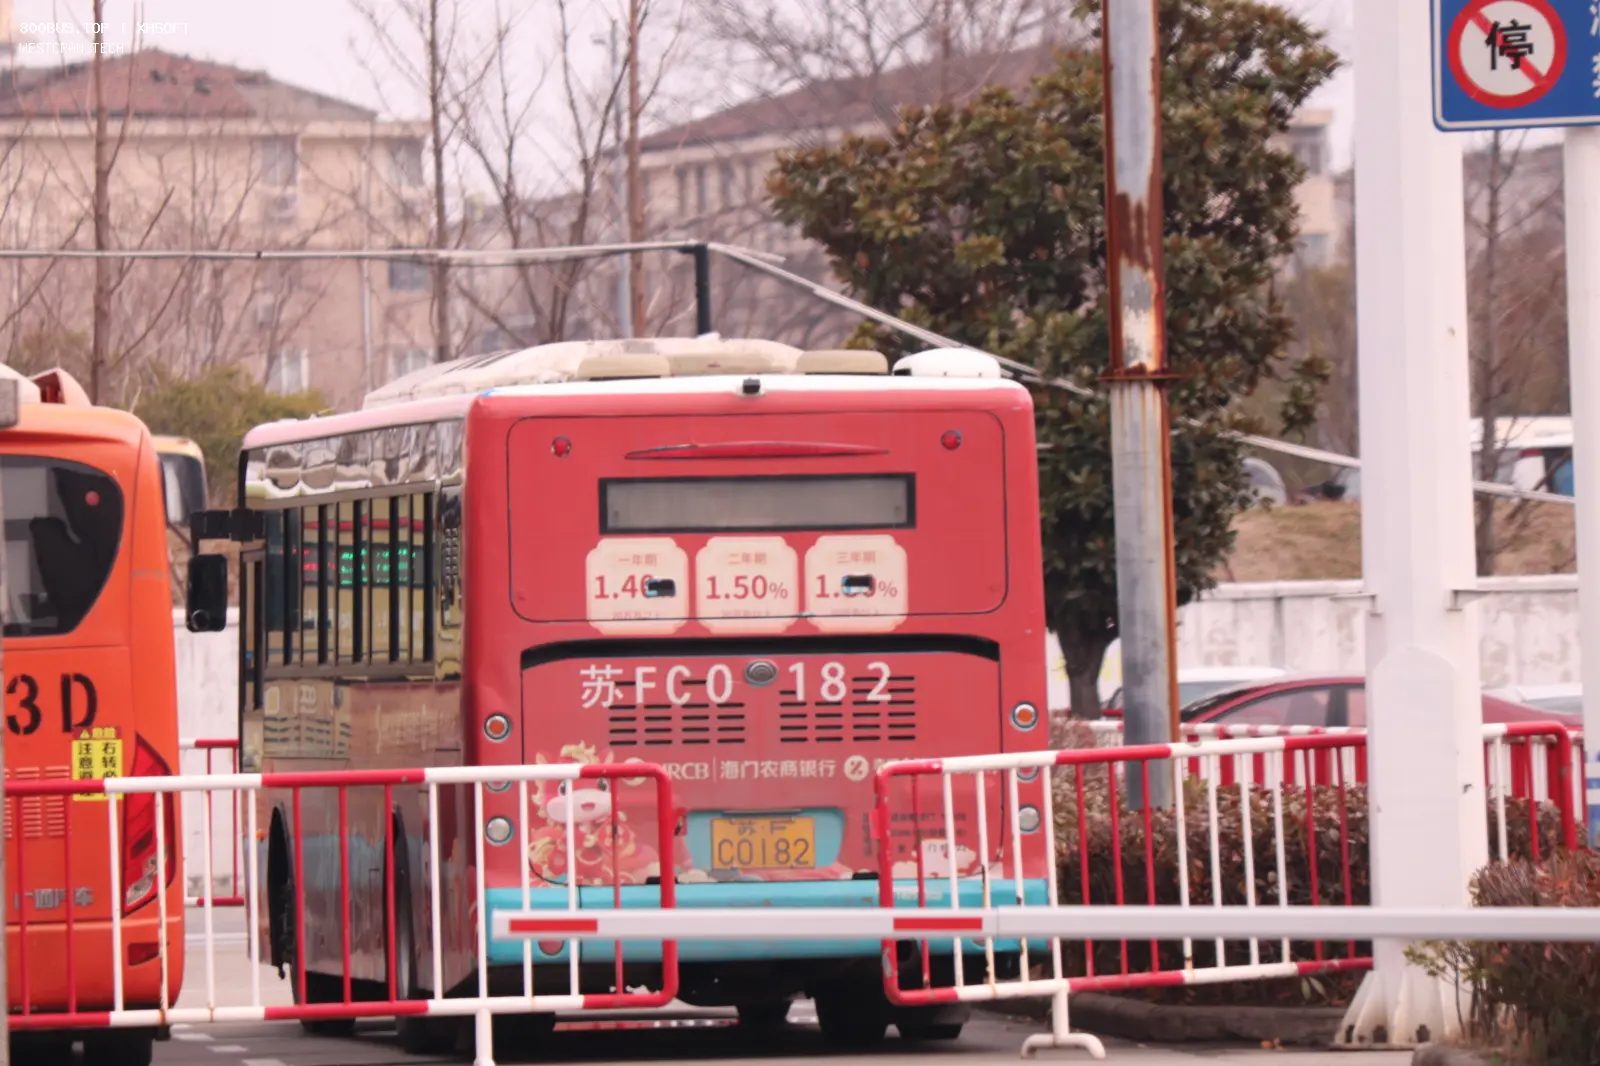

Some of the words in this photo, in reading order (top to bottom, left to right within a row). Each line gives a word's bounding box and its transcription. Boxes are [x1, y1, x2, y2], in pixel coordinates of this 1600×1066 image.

[1485, 19, 1534, 70] 停
[706, 574, 789, 600] 1.50%
[720, 759, 837, 780] 海门农商银行
[718, 838, 810, 866] C0182
